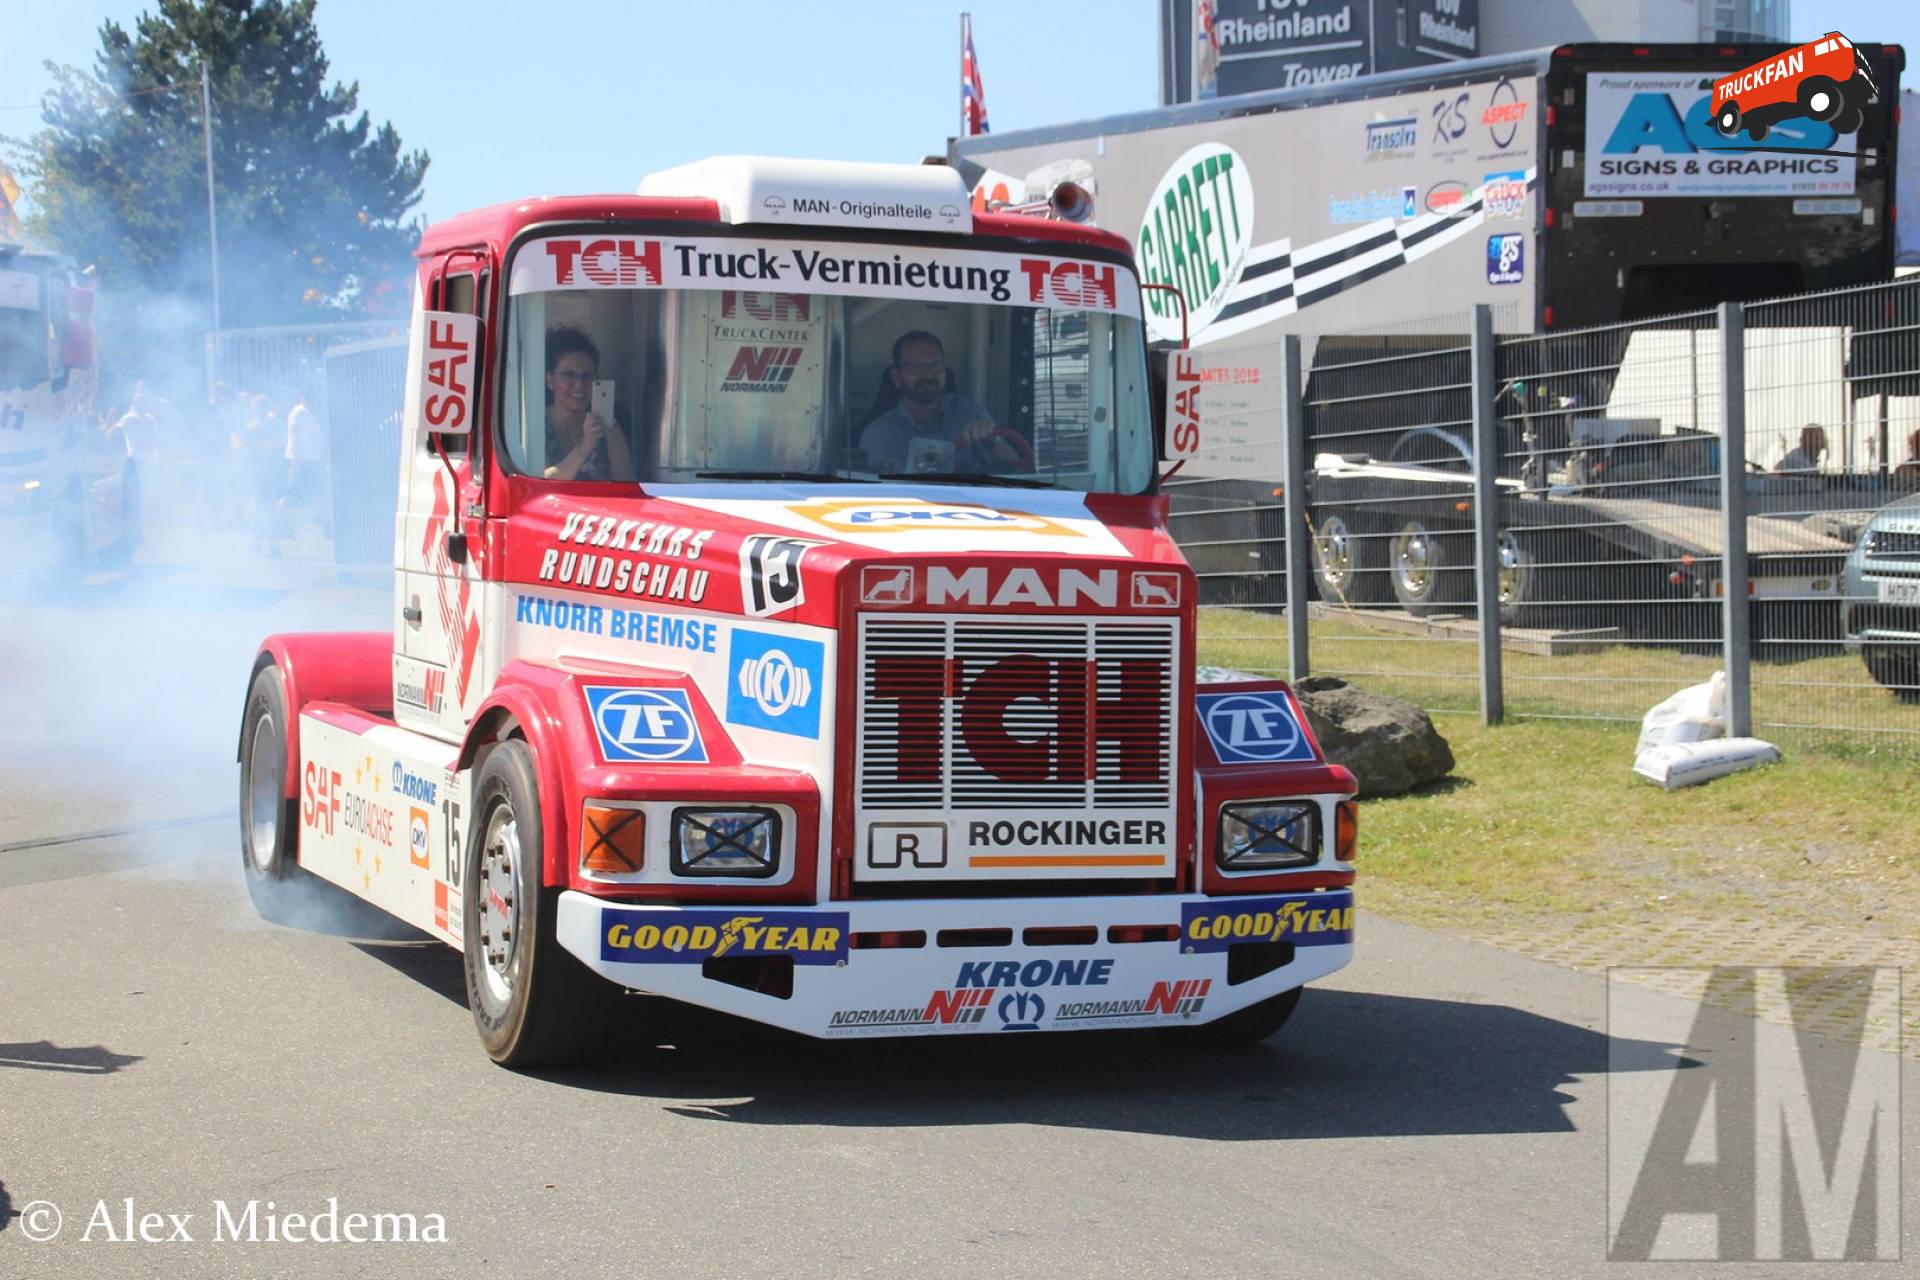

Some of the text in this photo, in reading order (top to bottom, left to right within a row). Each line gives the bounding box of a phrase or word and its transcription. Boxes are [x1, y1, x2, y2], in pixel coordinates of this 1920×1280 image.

[1219, 6, 1350, 46] Rheinland
[1283, 62, 1364, 89] Tower
[1481, 102, 1529, 126] ASPECT
[1600, 159, 1839, 175] SIGNS & GRAPHICS
[1141, 153, 1241, 318] GARRETT
[546, 239, 1117, 309] TCH Truck-Vermietung TCH
[425, 320, 468, 428] SAF
[720, 381, 788, 393] NORMANN
[1173, 353, 1201, 454] SAF
[558, 512, 716, 560] VERKEHRS
[539, 548, 709, 602] RUNDSCHAU
[926, 566, 1118, 607] MAN
[517, 595, 718, 653] KNORR BREMSE
[603, 702, 690, 747] ZF
[874, 654, 1161, 781] TCH
[1211, 706, 1294, 749] ZF
[304, 760, 342, 836] SAF
[403, 773, 437, 806] KRONE
[345, 791, 394, 848] EUROACHSE
[969, 820, 1165, 846] ROCKINGER
[442, 798, 461, 888] 15
[955, 958, 1115, 988] KRONE
[831, 1008, 924, 1025] NORMANN
[1056, 999, 1146, 1017] NORMANN
